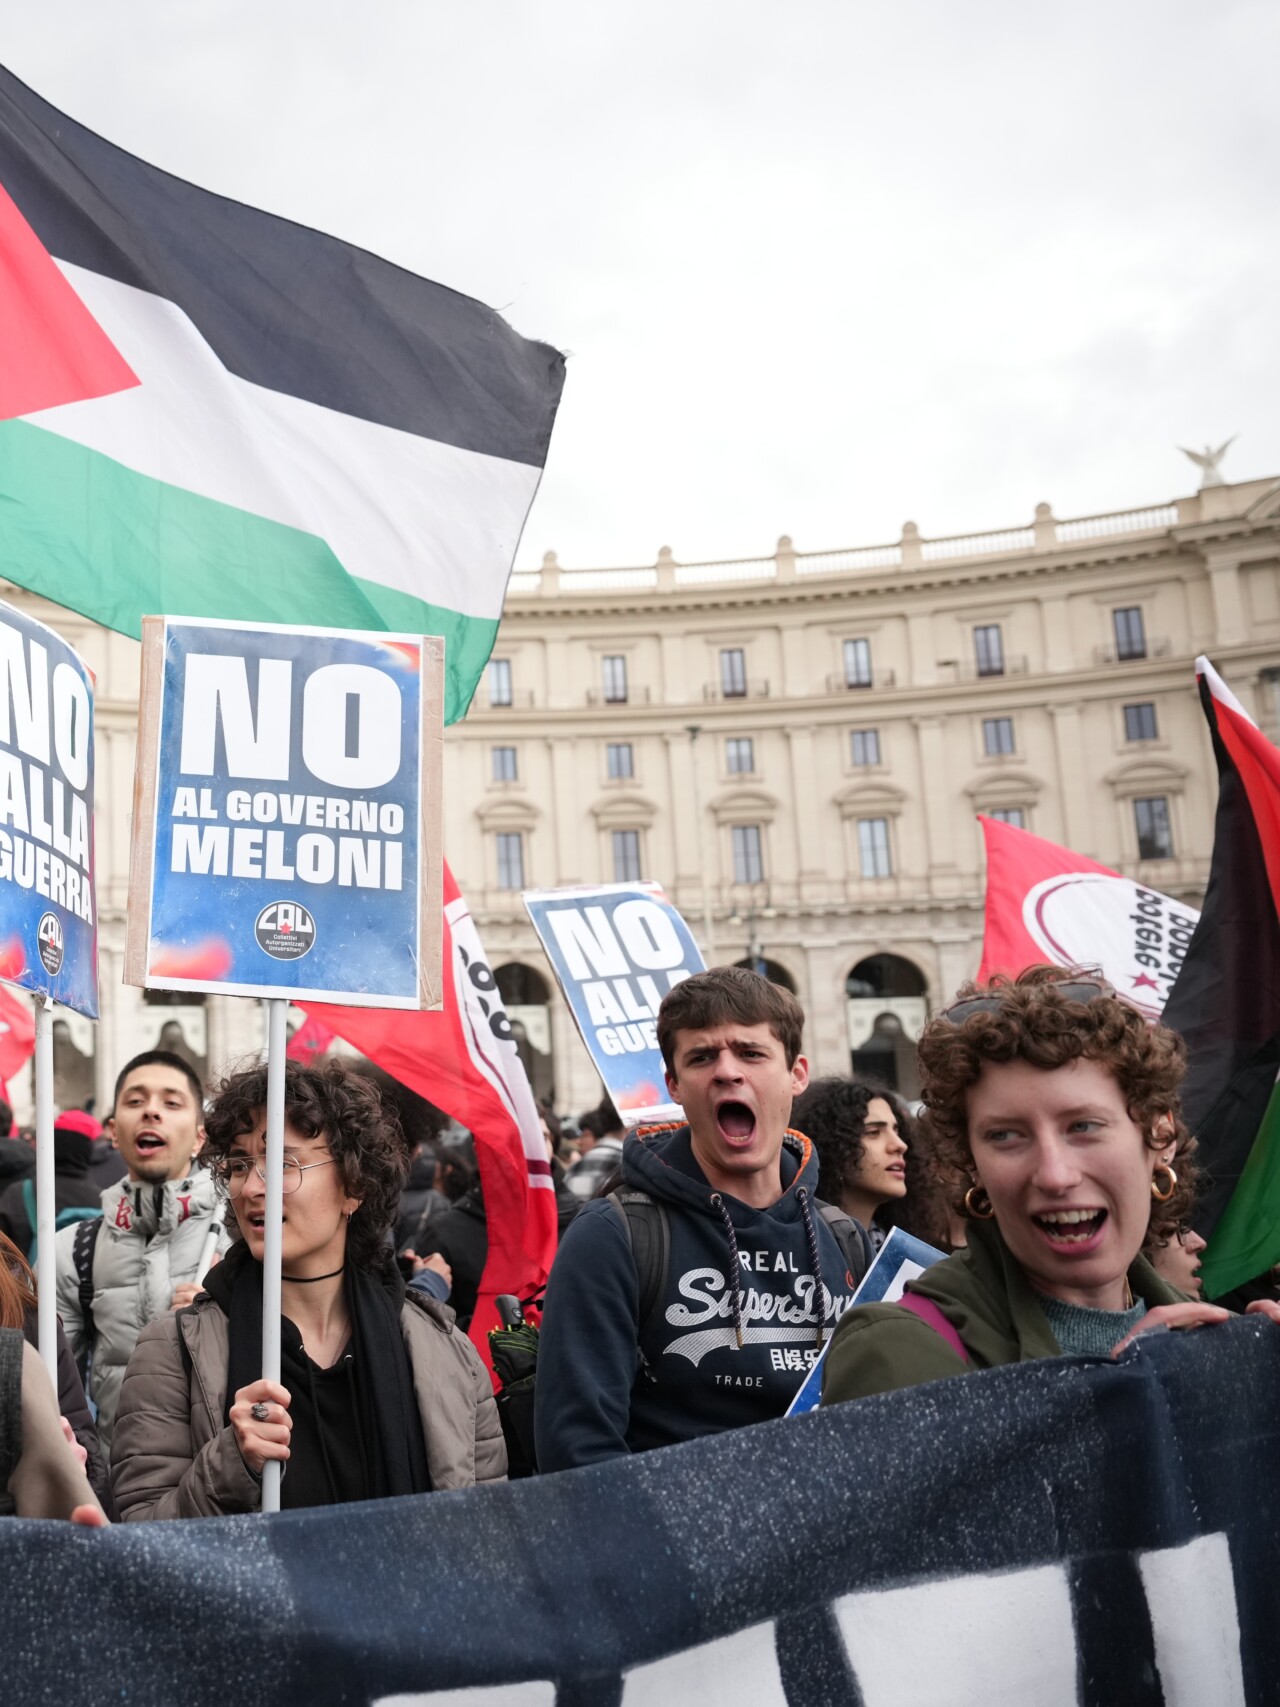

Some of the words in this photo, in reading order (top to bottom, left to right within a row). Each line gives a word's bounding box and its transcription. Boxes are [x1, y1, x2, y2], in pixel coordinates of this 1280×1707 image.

[180, 652, 402, 790] NO
[172, 787, 218, 819] AL
[226, 790, 404, 835] GOVERNO
[171, 823, 403, 891] MELONI
[266, 940, 305, 948] Autorganizzati
[545, 899, 684, 981] NO
[596, 1021, 659, 1056] GUE
[738, 1250, 799, 1272] REAL
[715, 1375, 763, 1388] TRADE
